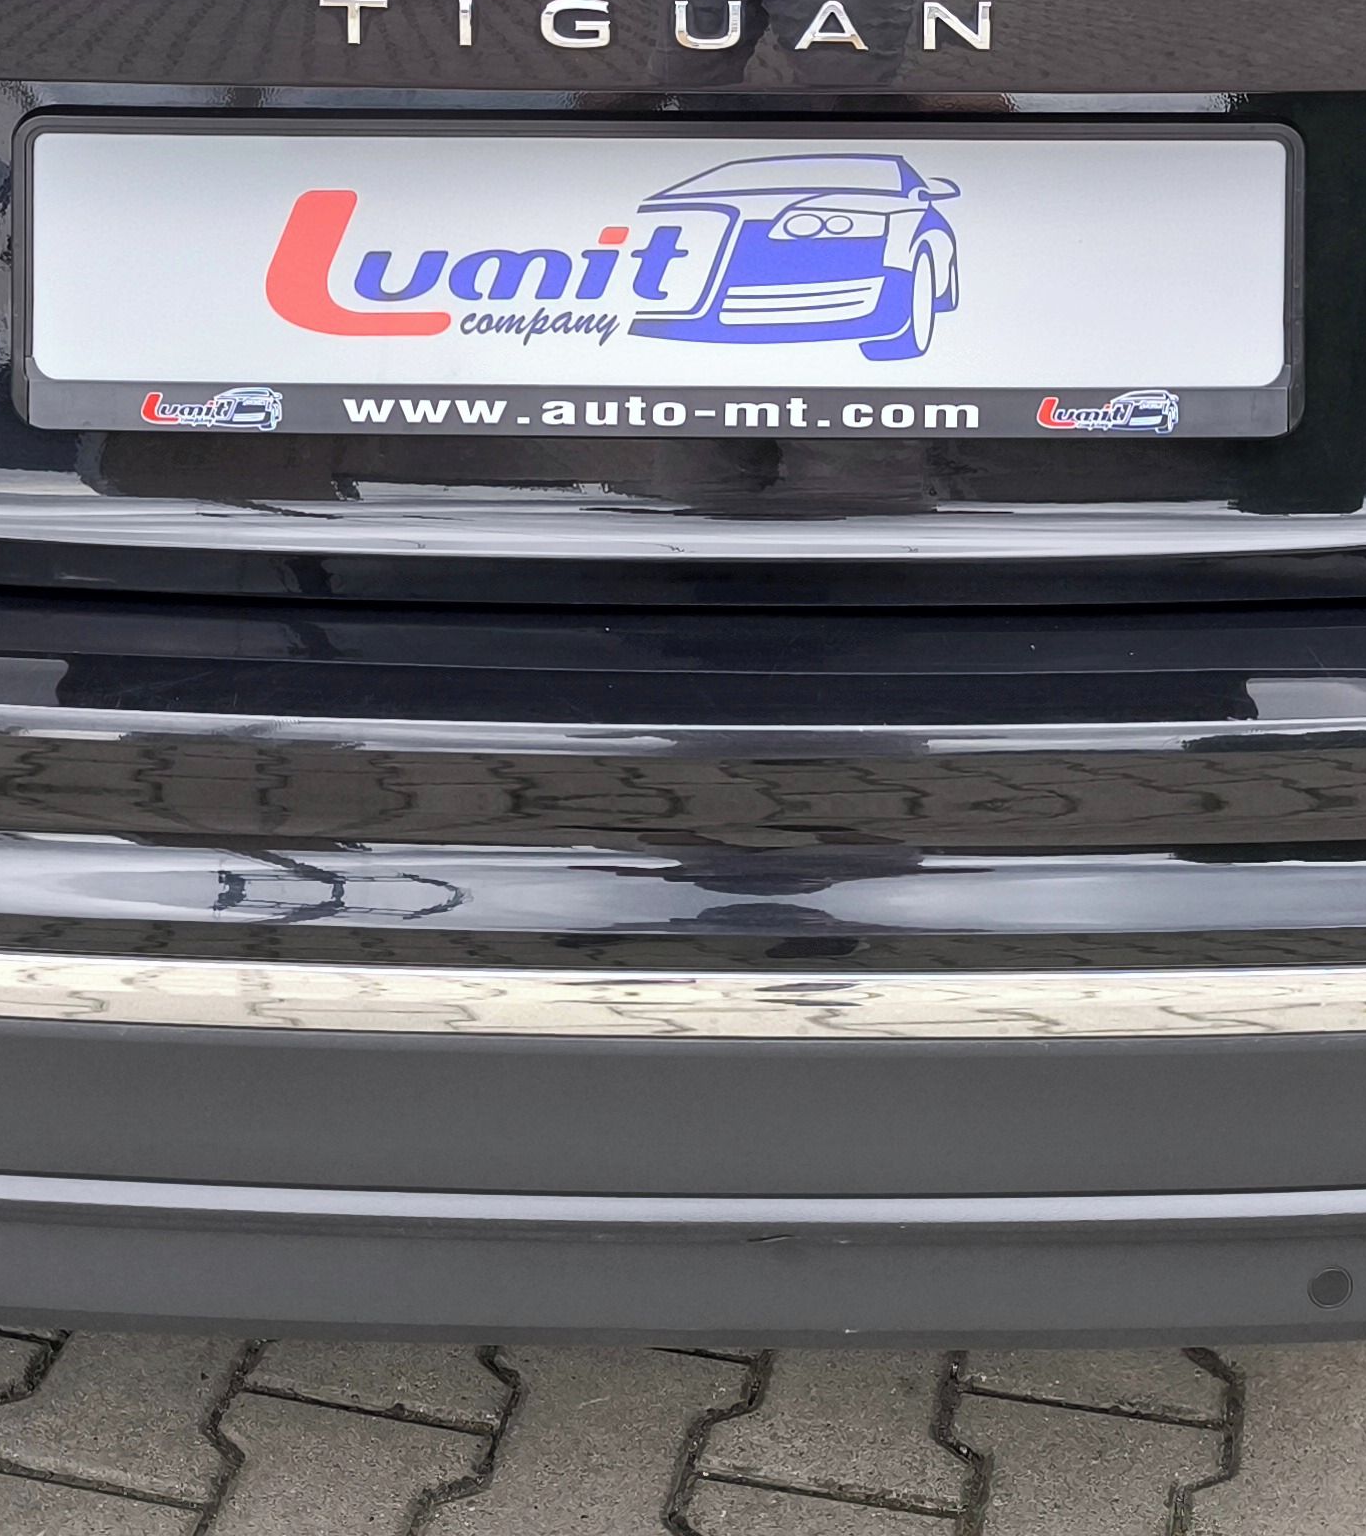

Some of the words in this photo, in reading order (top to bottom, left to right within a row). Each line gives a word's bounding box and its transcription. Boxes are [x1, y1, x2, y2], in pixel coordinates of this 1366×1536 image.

[264, 189, 689, 337] Lumit
[460, 307, 620, 346] company
[141, 392, 229, 424] Lumit
[343, 395, 979, 429] www.auto-mt.com
[1037, 397, 1126, 428] Lumit
